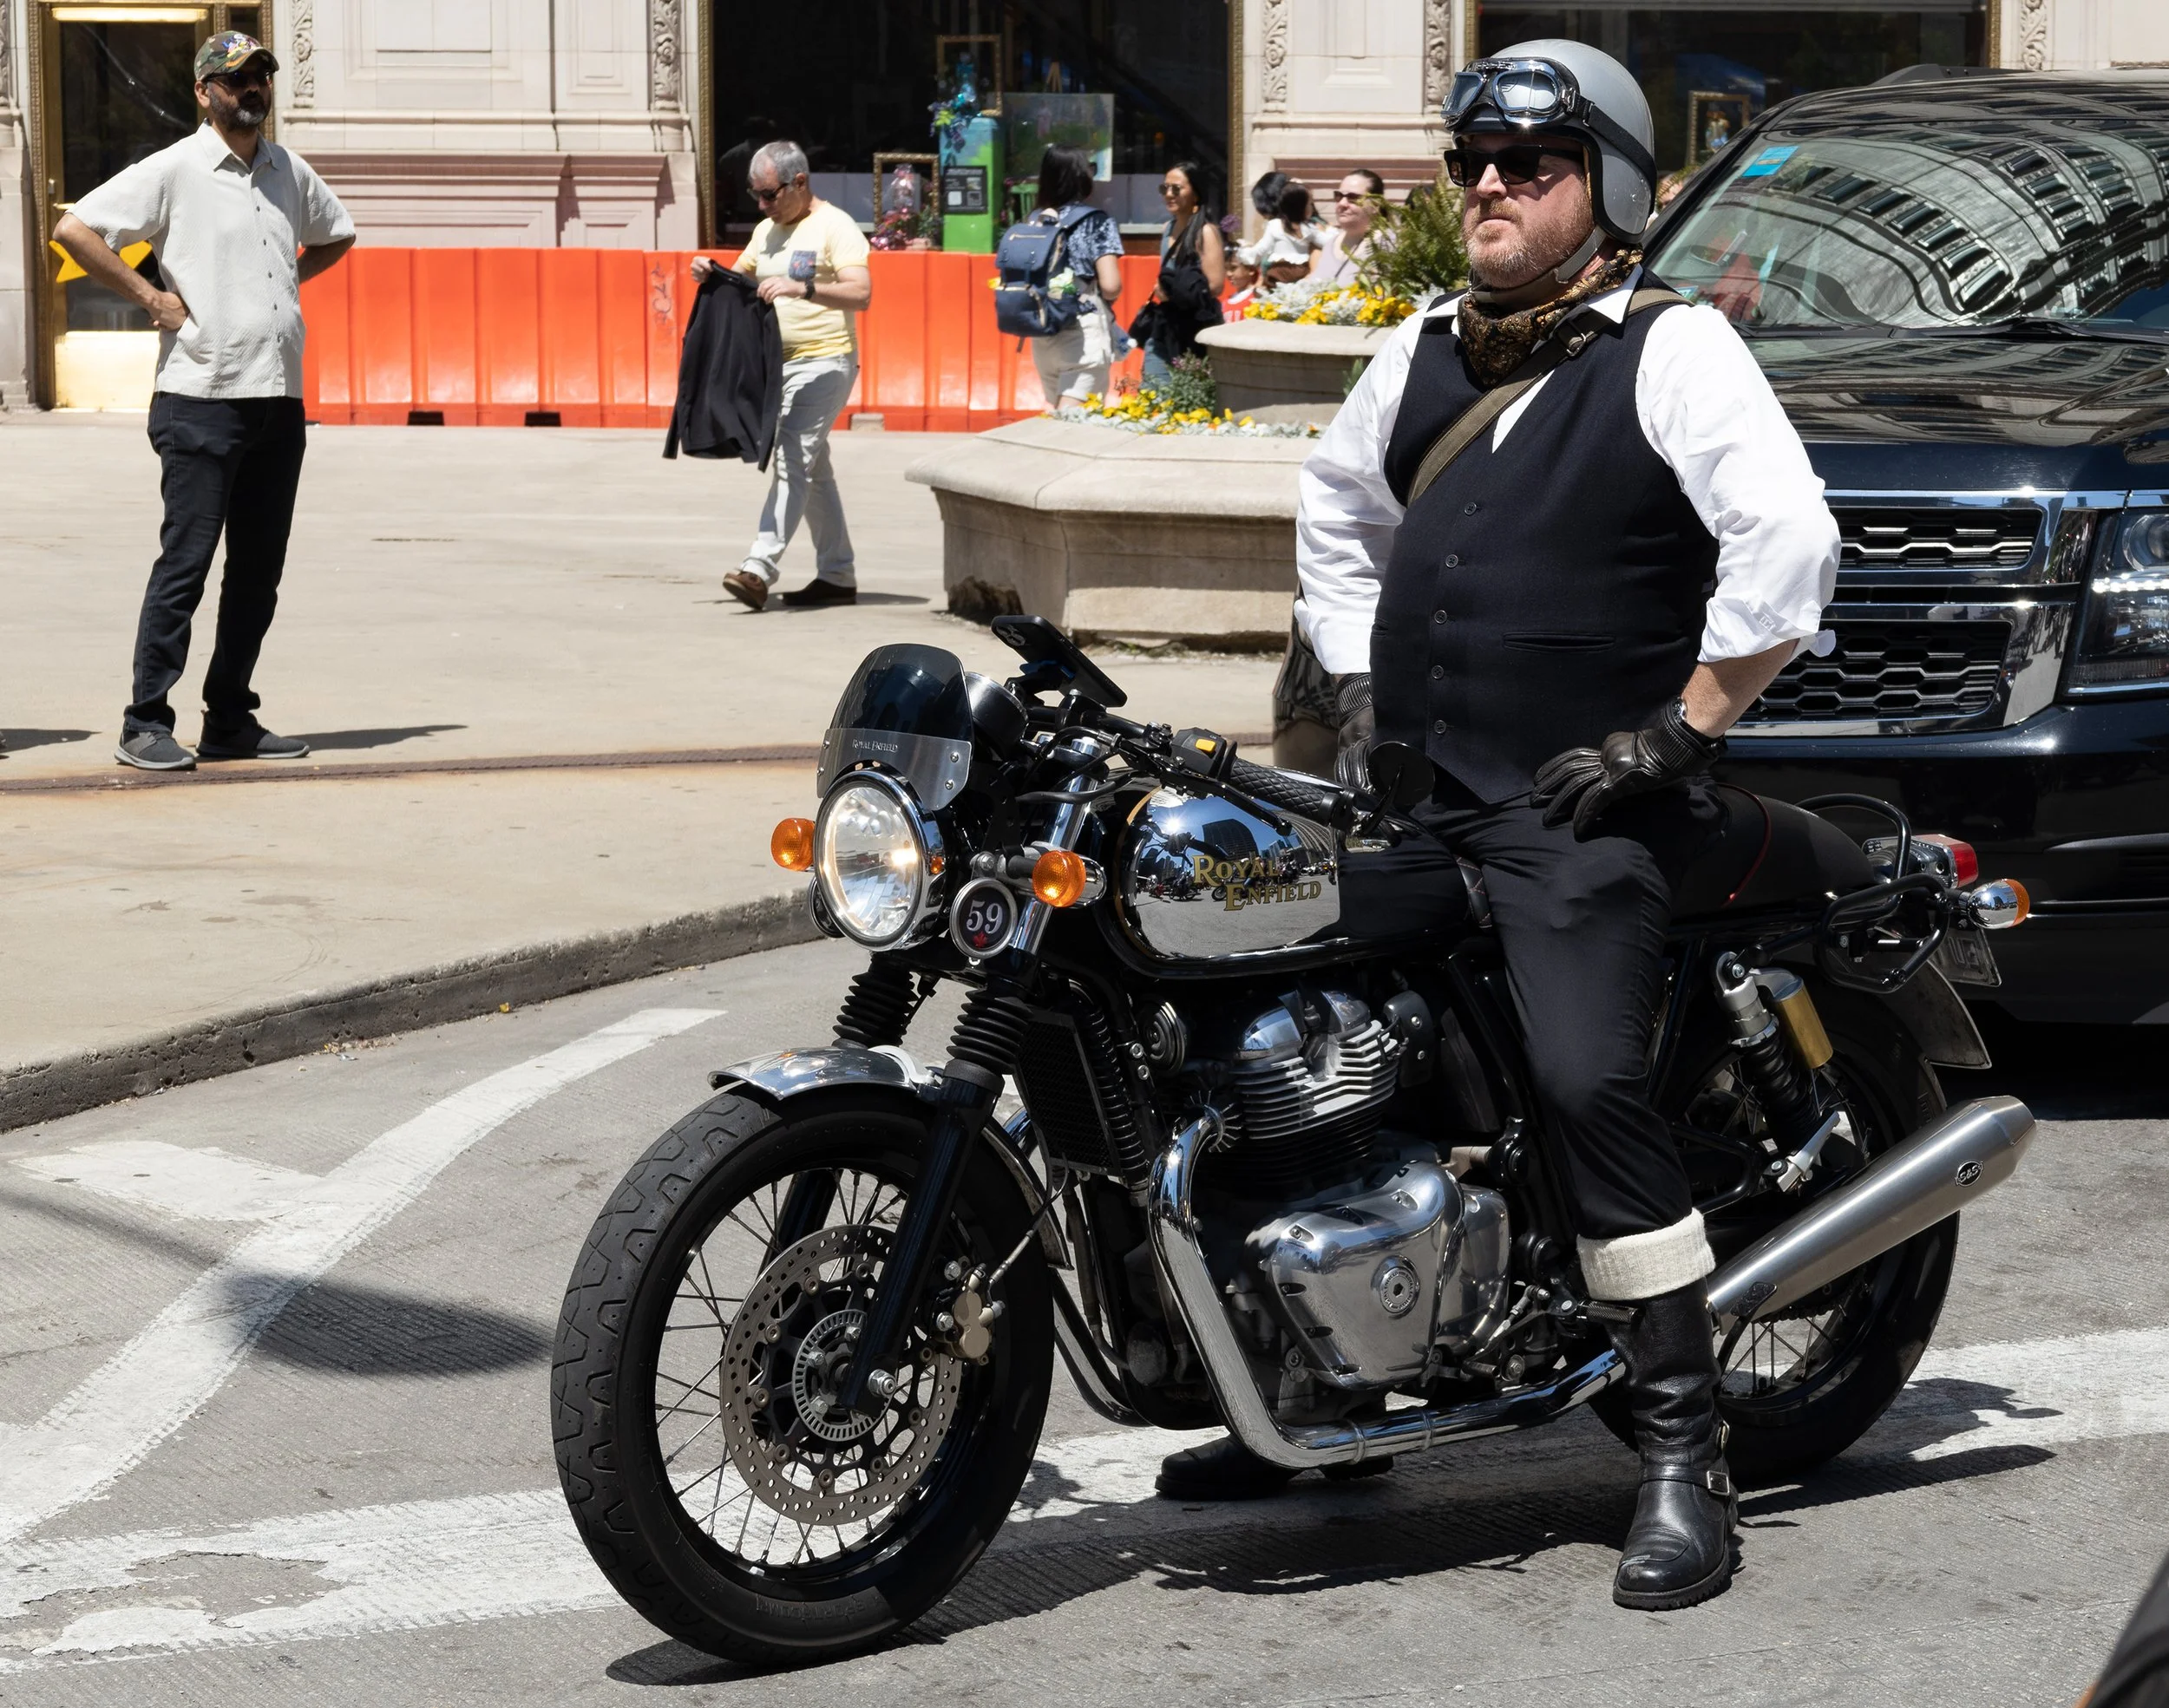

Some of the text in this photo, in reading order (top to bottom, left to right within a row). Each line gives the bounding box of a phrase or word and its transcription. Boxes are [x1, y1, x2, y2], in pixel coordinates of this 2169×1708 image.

[853, 739, 870, 749] ROYAL
[1193, 854, 1280, 886] ROYAL
[1223, 880, 1322, 911] ENFIELD
[966, 900, 1003, 934] 59
